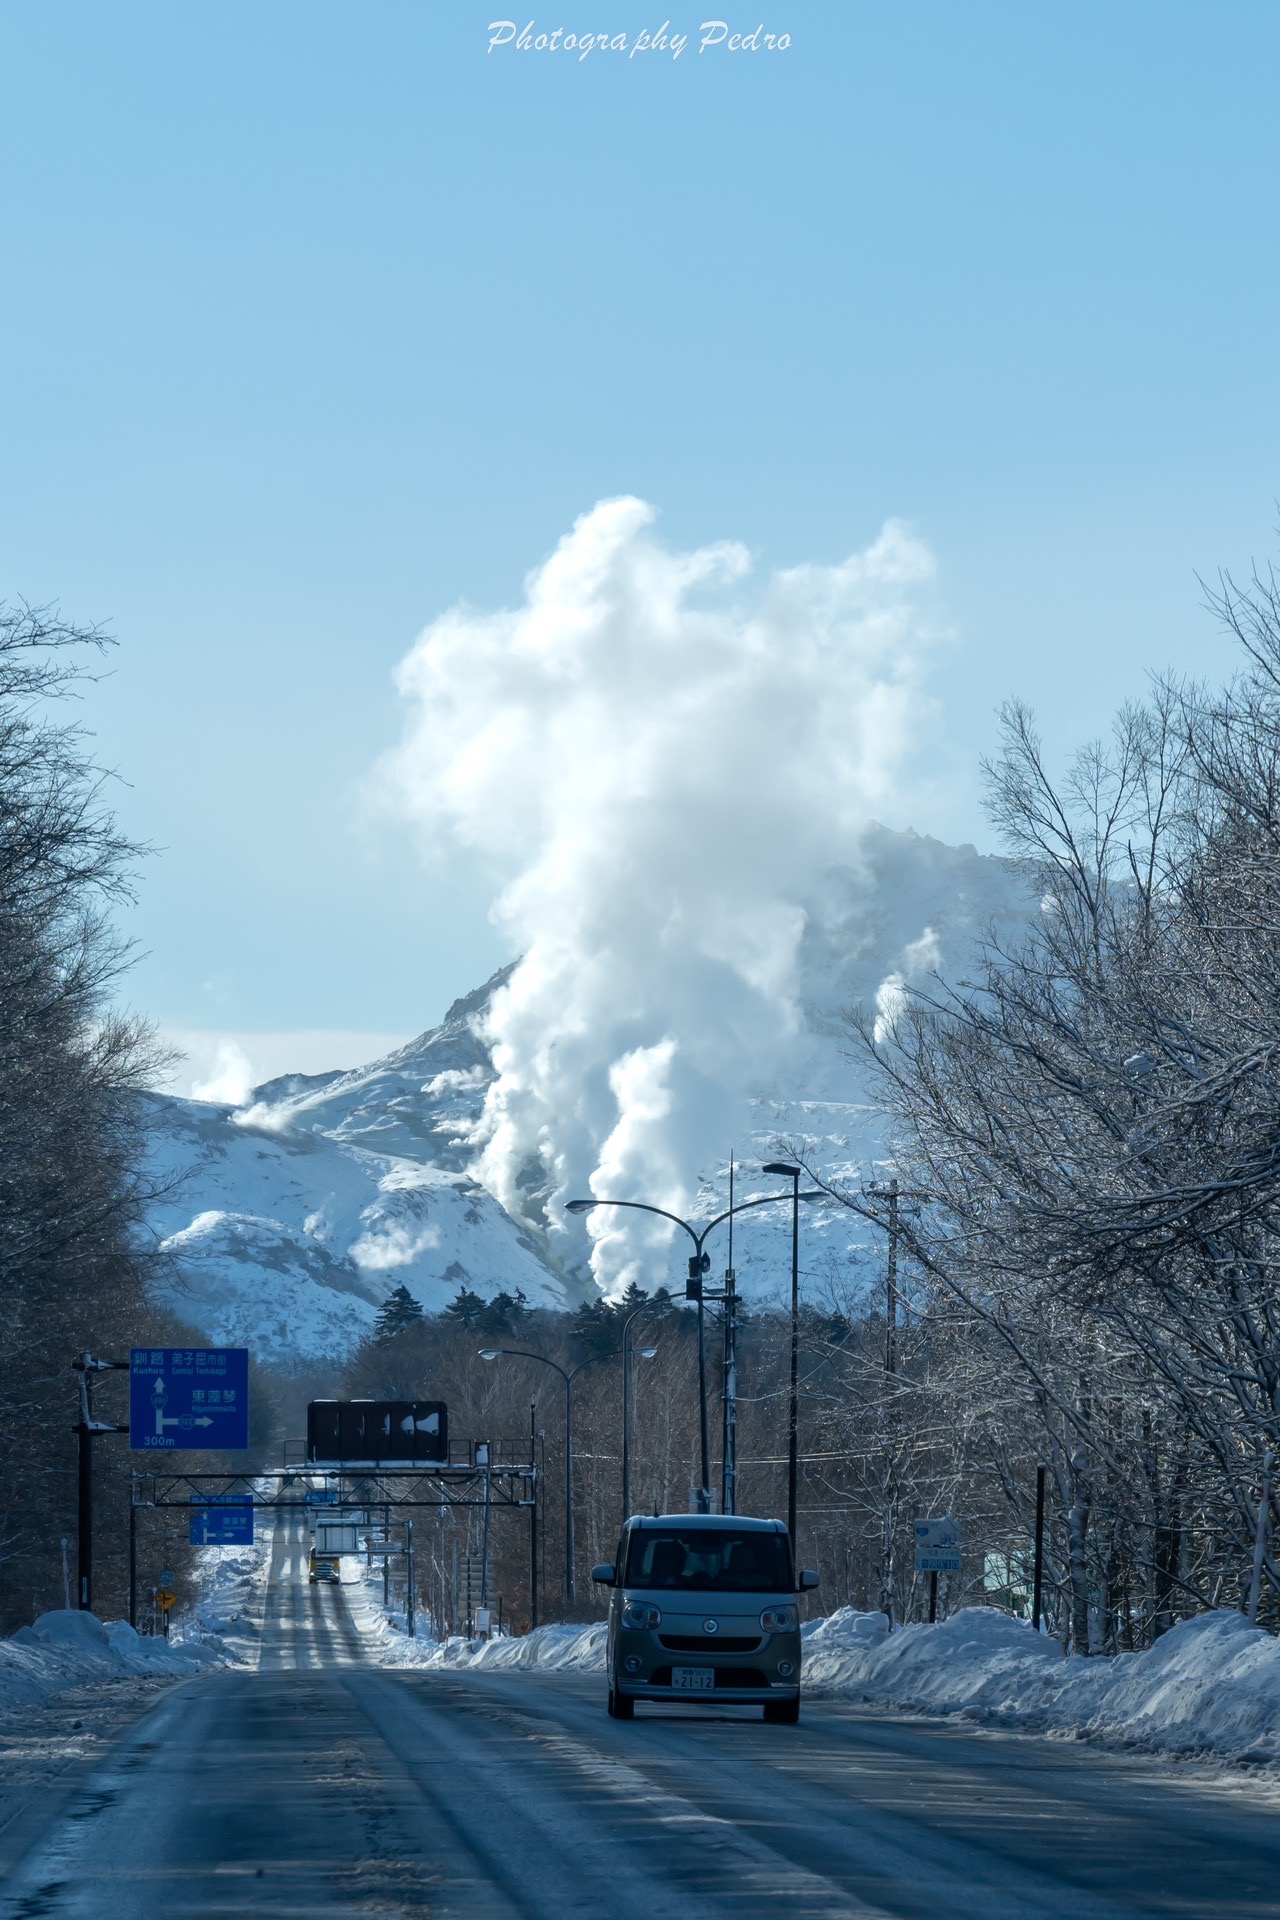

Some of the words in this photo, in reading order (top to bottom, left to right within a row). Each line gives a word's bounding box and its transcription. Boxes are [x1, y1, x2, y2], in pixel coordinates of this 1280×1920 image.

[133, 1352, 164, 1365] 釧路
[133, 1367, 164, 1375] Kushiro
[171, 1367, 194, 1375] Central
[144, 1436, 175, 1447] 300m
[681, 1676, 712, 1689] 21-12
